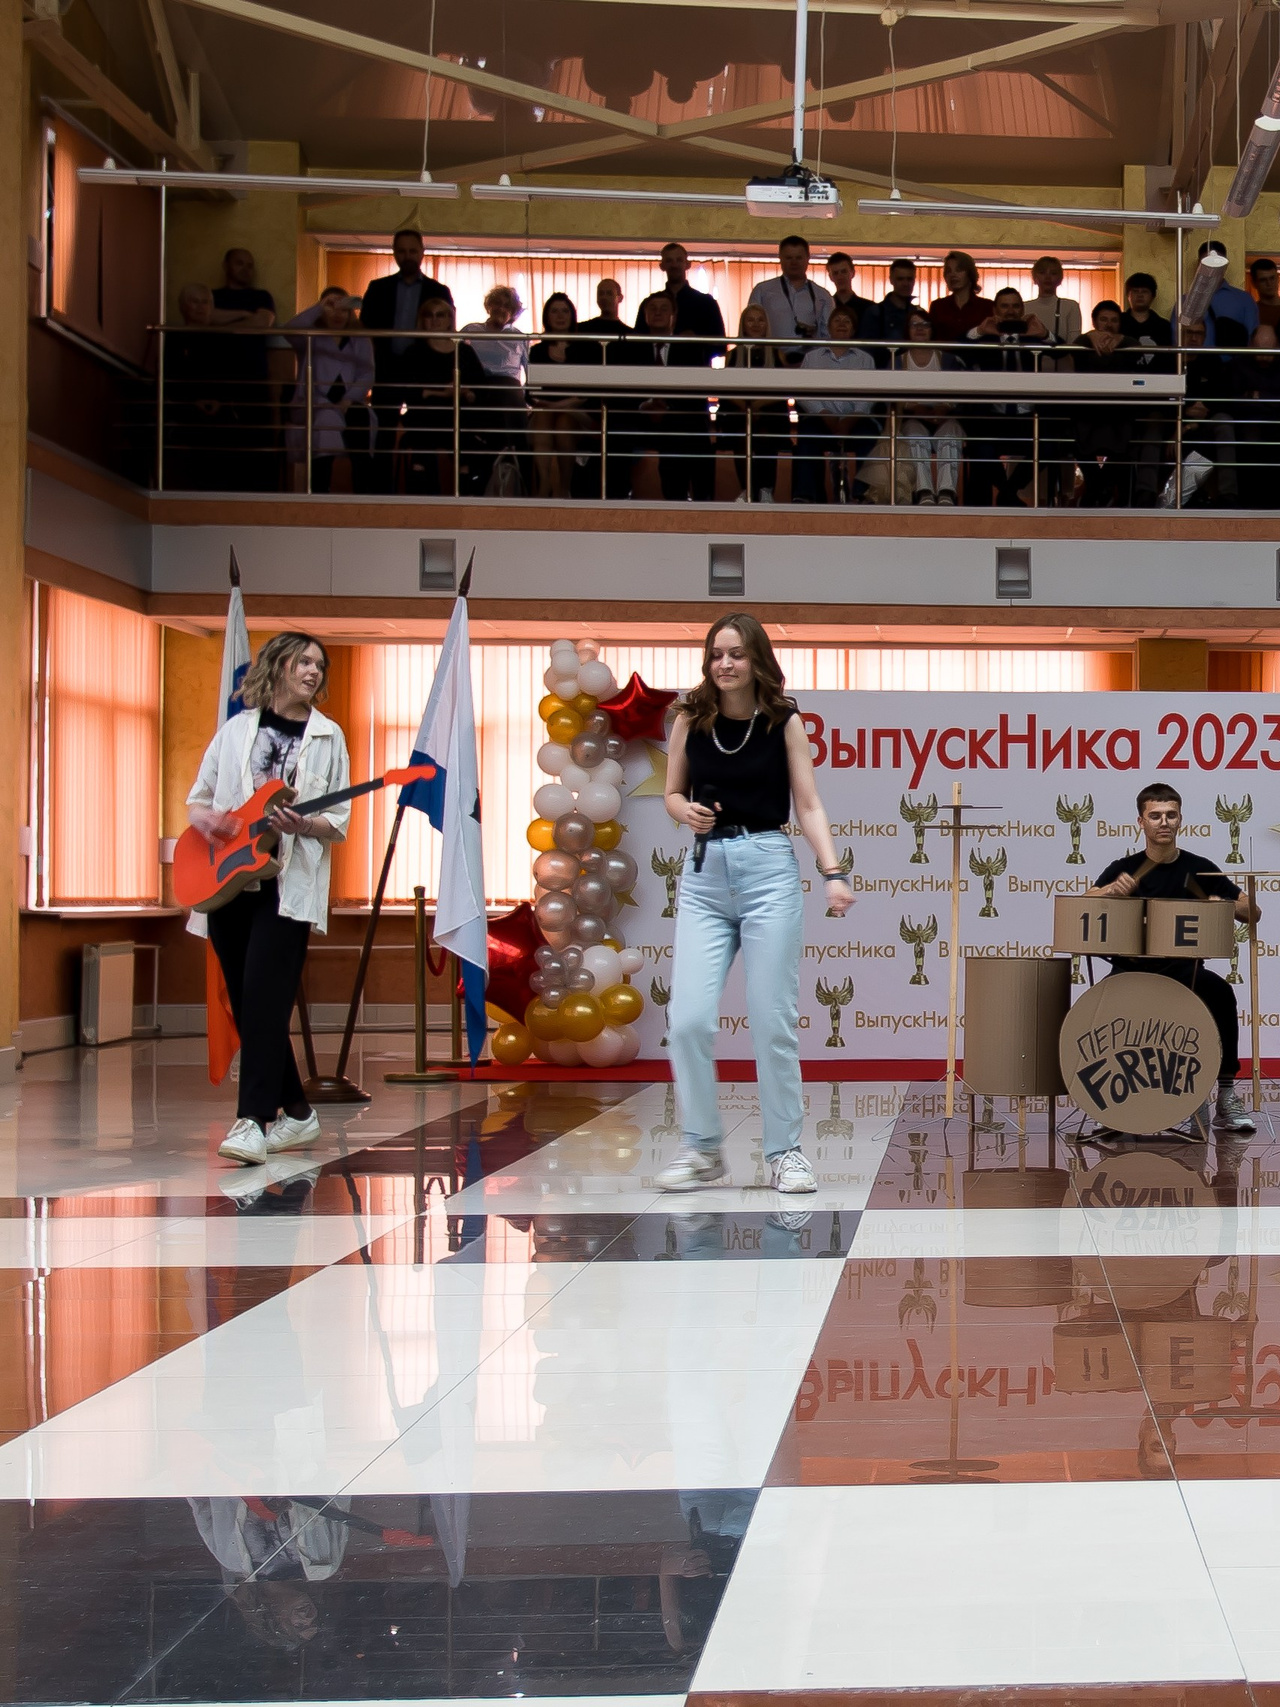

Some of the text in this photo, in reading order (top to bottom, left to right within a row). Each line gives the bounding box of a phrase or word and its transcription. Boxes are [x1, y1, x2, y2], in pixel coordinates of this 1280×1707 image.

[800, 712, 1140, 790] ВыпускНика
[940, 819, 1055, 843] ВпускНика
[1097, 820, 1211, 843] Выпуика
[1008, 875, 1095, 899] ВыпускН
[1079, 912, 1108, 943] 11
[939, 940, 1054, 958] ВпускНика
[1076, 1017, 1200, 1062] ПЕРШИКОВ
[1076, 1046, 1202, 1112] FOREVER
